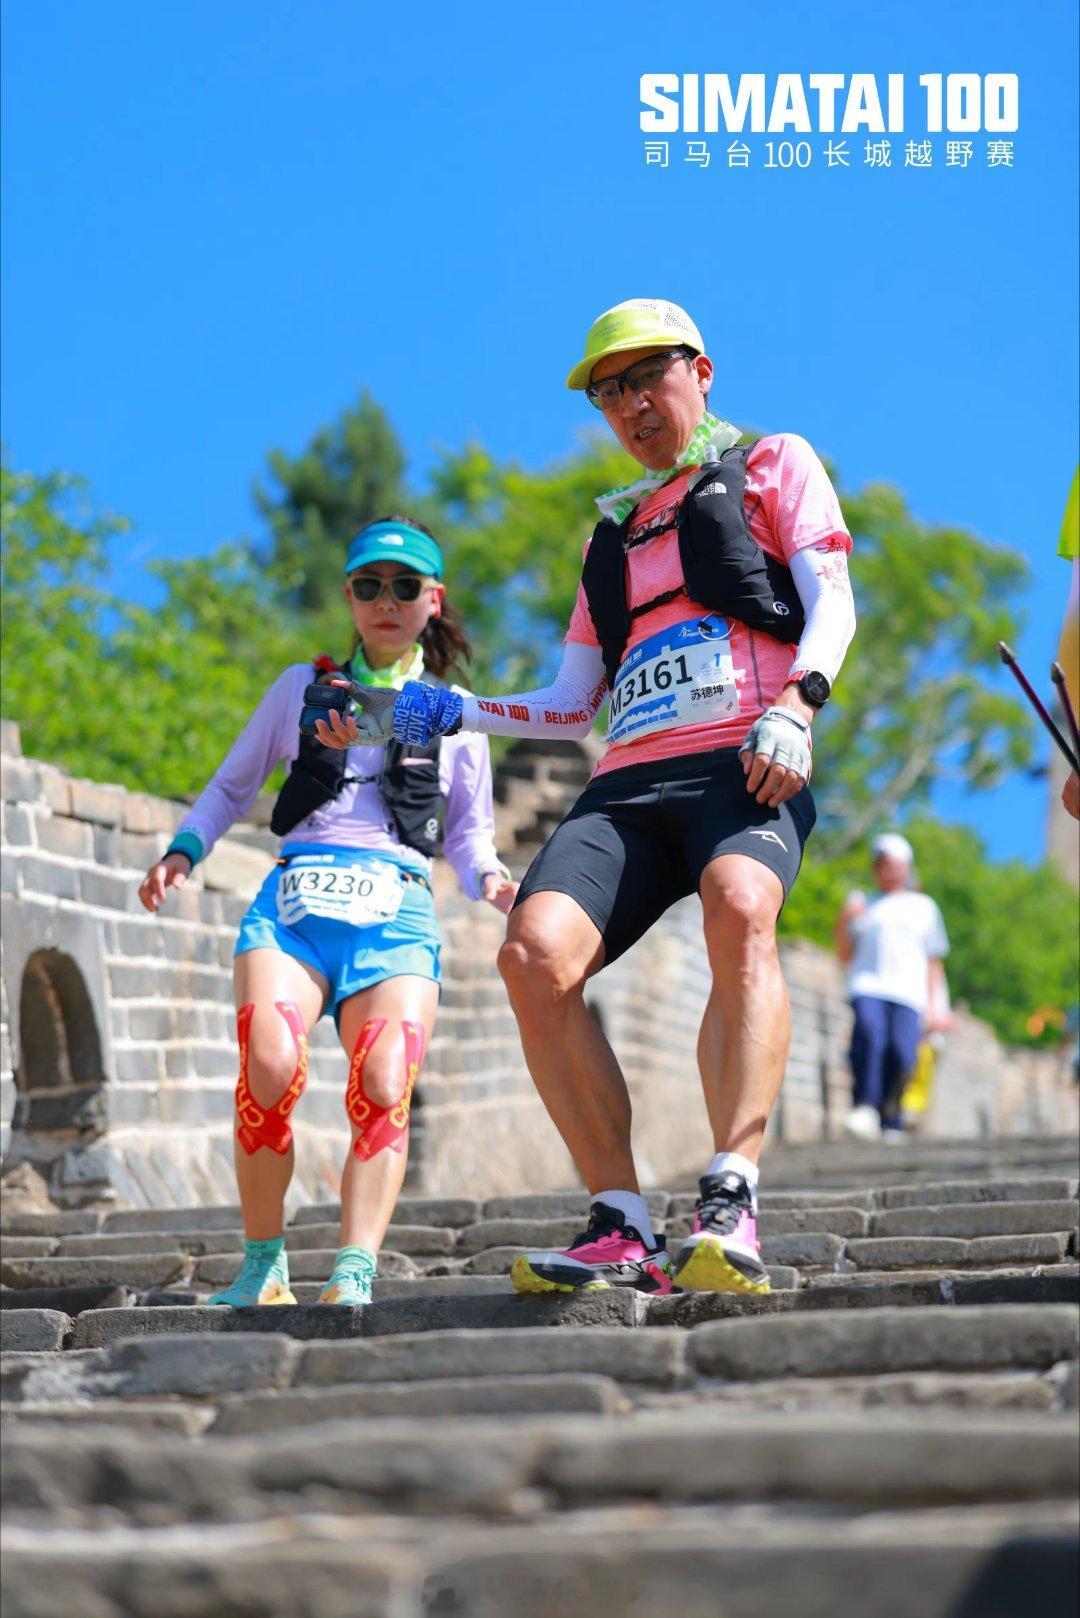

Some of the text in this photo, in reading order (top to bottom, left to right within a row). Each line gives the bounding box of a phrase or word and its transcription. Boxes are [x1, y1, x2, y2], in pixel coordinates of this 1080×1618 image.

[609, 654, 693, 724] M3161
[544, 710, 588, 724] BEIJING
[282, 871, 374, 898] W3230
